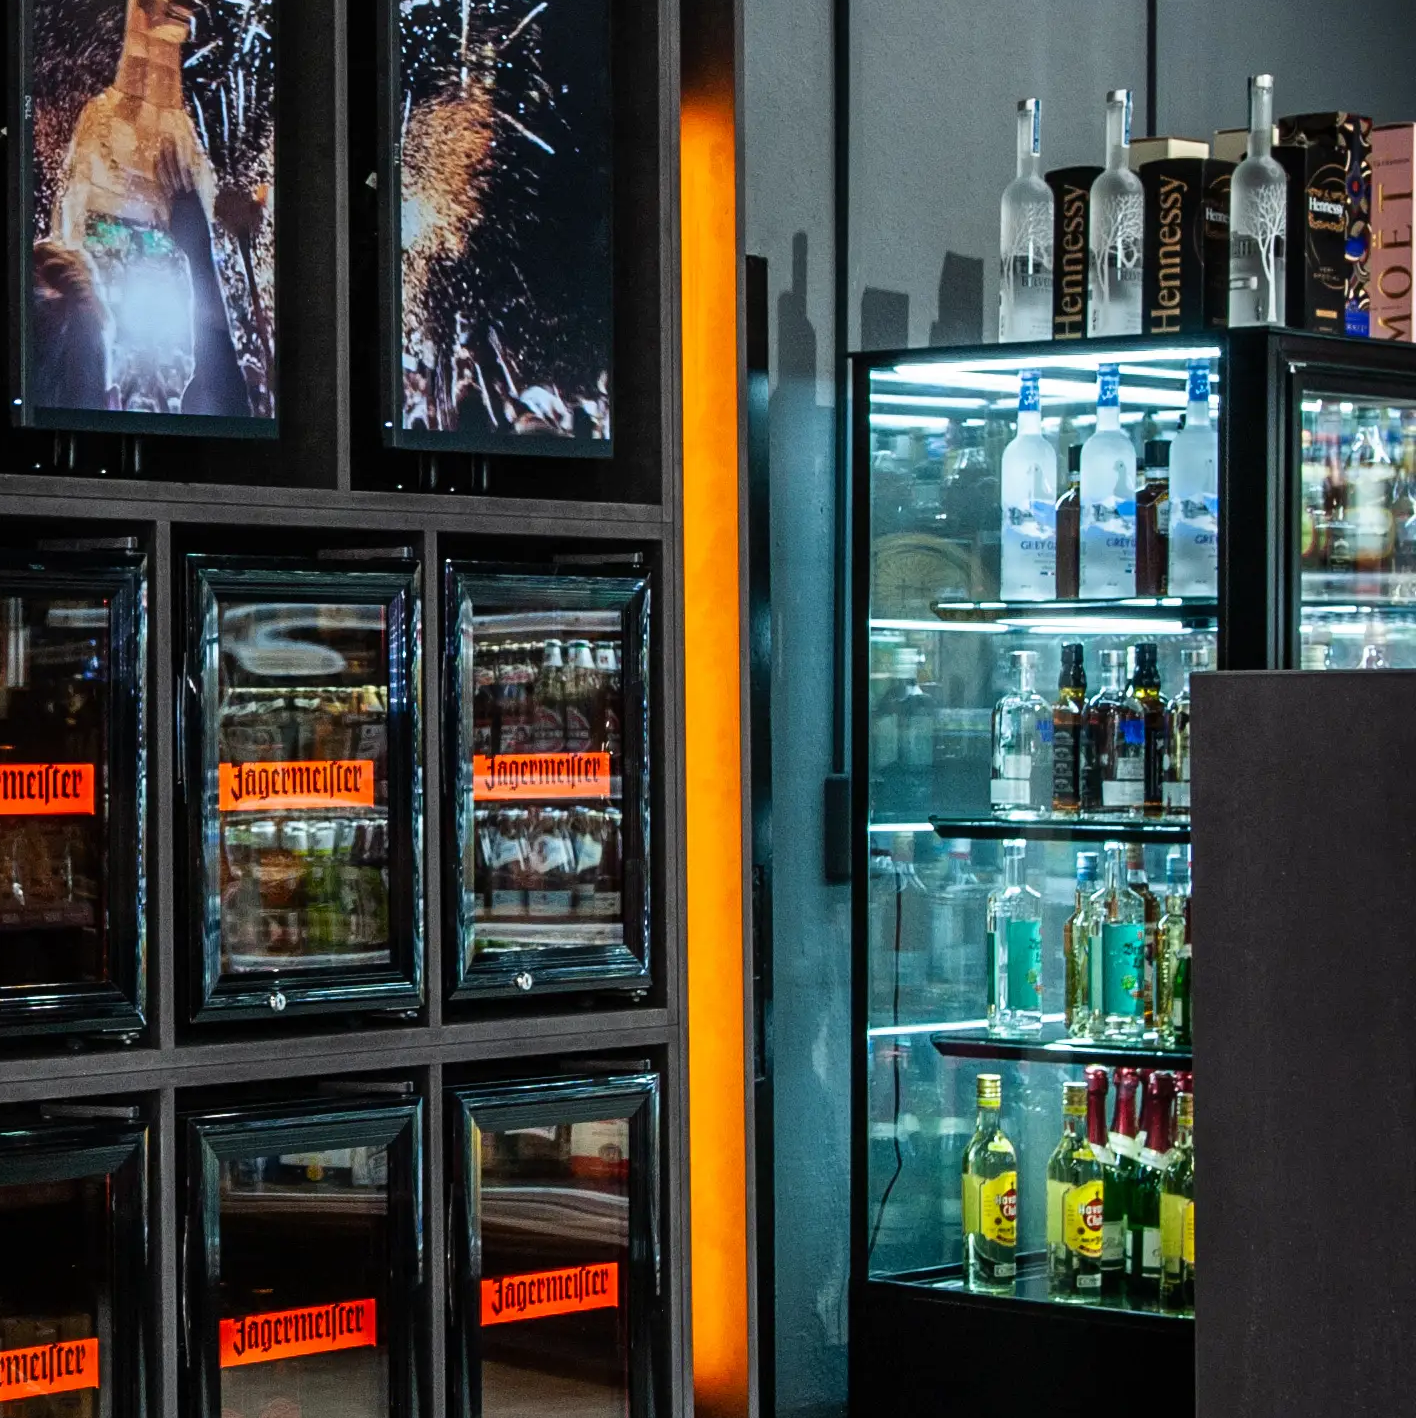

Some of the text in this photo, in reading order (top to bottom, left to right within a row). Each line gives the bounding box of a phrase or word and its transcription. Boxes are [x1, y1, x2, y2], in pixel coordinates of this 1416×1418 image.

[1308, 197, 1344, 216] Hennessy
[1054, 183, 1090, 340] Hennessy
[1150, 174, 1188, 334] Hennessy
[231, 760, 362, 800] Jägermeister
[484, 753, 601, 791] Jägermeister
[491, 1265, 609, 1316] Jägermeister
[233, 1302, 364, 1356] Jägermeister
